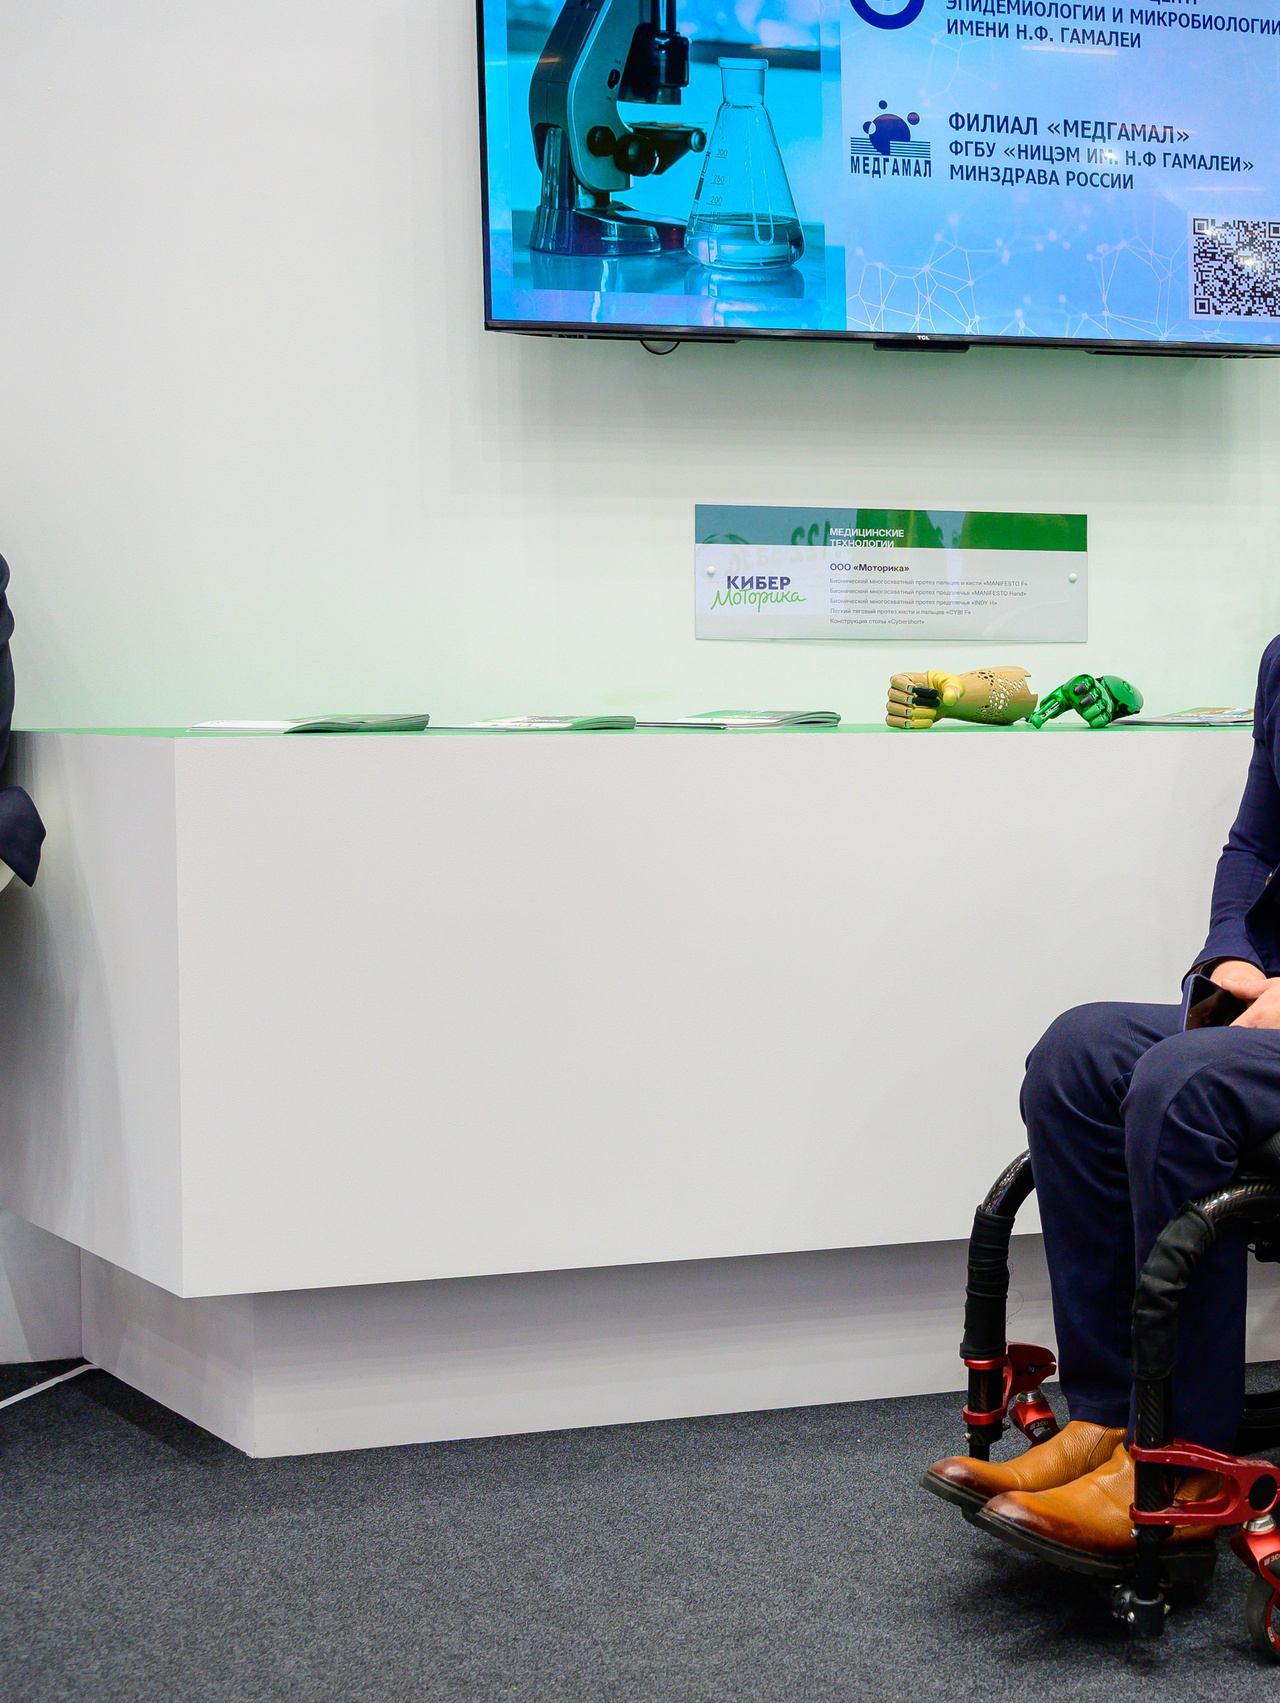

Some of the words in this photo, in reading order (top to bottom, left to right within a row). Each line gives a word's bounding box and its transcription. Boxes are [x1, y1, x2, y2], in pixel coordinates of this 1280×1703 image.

[946, 0, 1105, 22] ЭПИДЕМИОЛОГИИ
[1112, 7, 1123, 23] И
[947, 18, 1009, 39] ИМЕНИ
[1016, 23, 1054, 42] Н.Ф.
[1060, 27, 1141, 48] ГАМАЛЕИ
[948, 111, 1038, 136] ФИЛИАЛ
[1047, 119, 1190, 143] «МЕДГАМАЛ»
[850, 155, 932, 178] МЕДГАМАЛ
[949, 140, 996, 158] ФГБУ
[1003, 143, 1080, 164] «НИЦЭМ
[1086, 147, 1119, 165] ИМ.
[1125, 150, 1157, 167] Н.Ф
[1163, 152, 1254, 172] ГАМАЛЕИ»
[713, 175, 725, 183] 250
[949, 164, 1060, 187] МИНЗДРАВА
[1066, 171, 1134, 189] РОССИИ
[710, 196, 722, 204] 200
[829, 528, 904, 538] МЕДИЦИНСКИЕ
[830, 539, 895, 548] ТЕХНОЛОГИИ
[829, 563, 851, 571] ООО
[853, 563, 910, 573] «Моторика»
[726, 575, 791, 590] КИБЕР
[710, 588, 807, 613] Моторика
